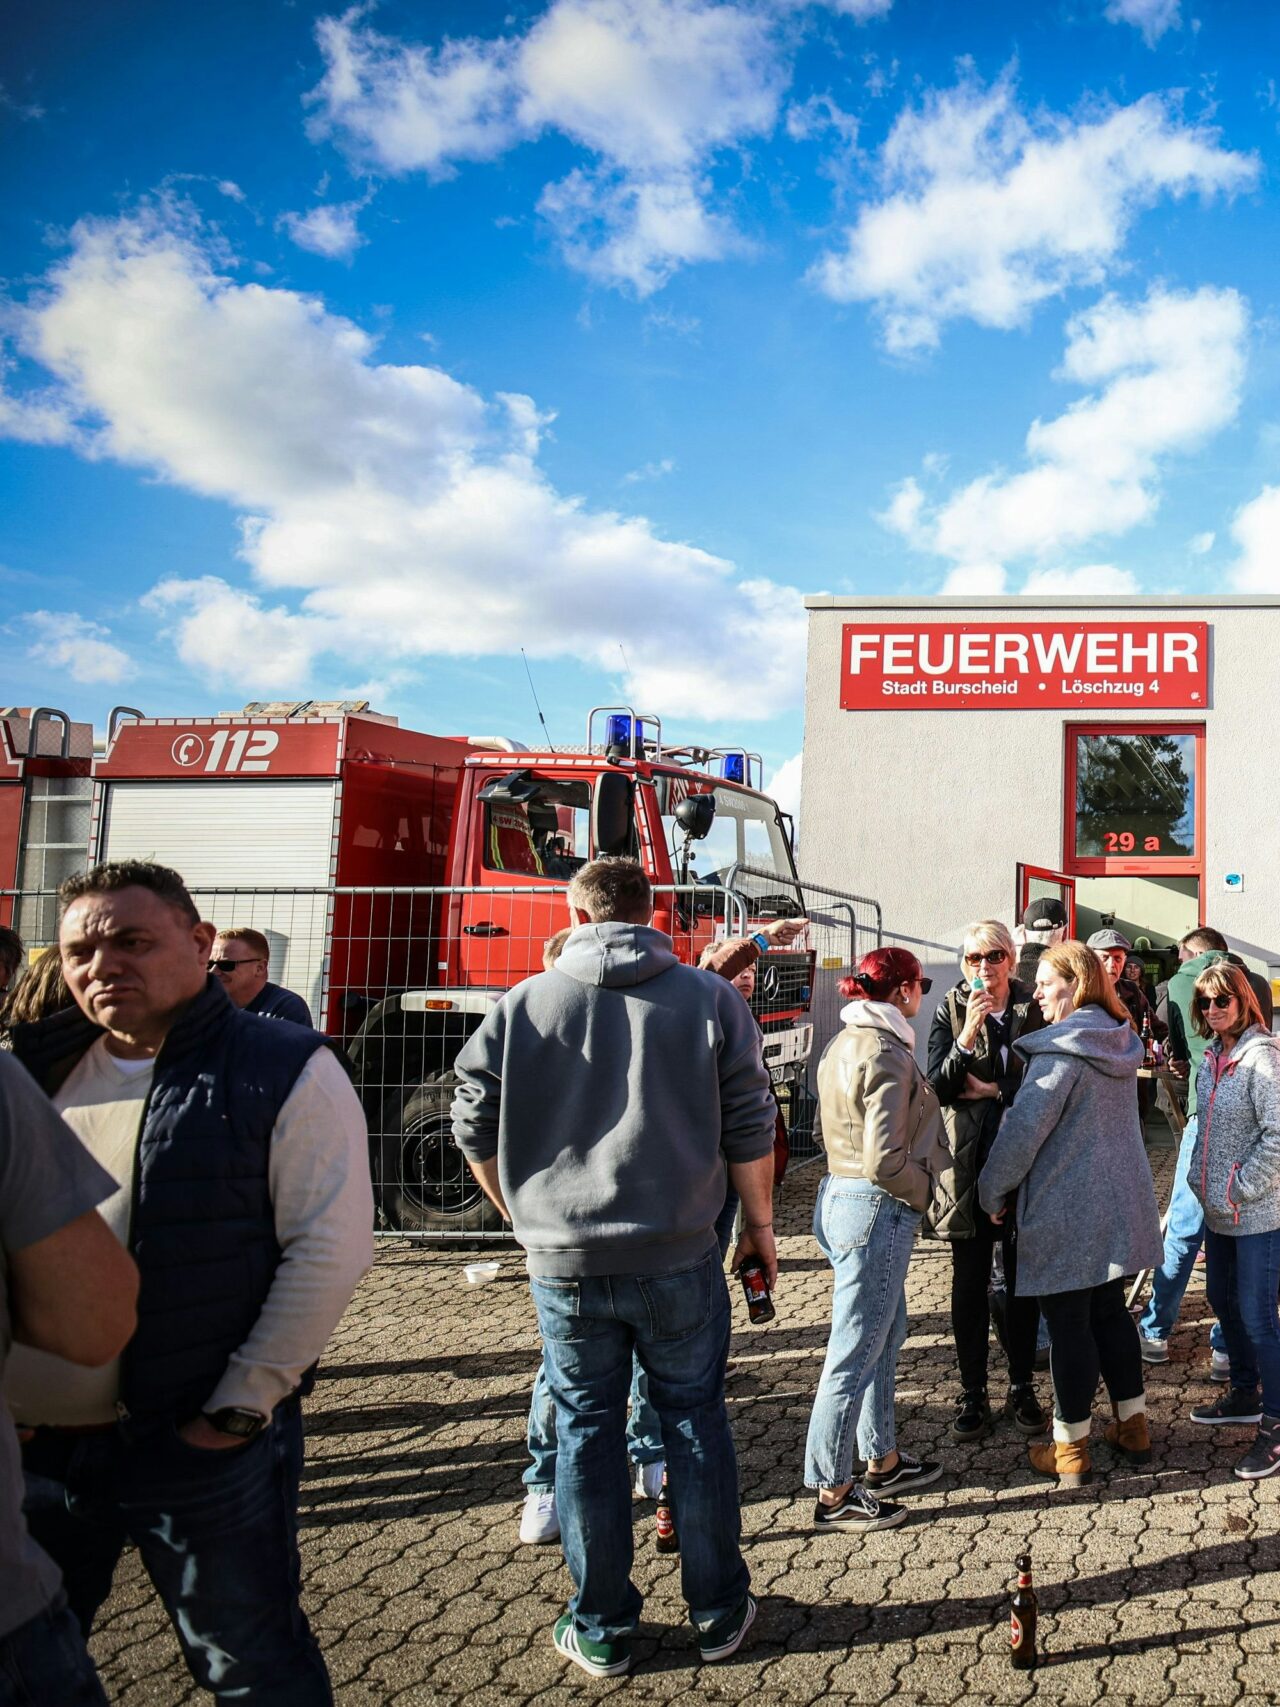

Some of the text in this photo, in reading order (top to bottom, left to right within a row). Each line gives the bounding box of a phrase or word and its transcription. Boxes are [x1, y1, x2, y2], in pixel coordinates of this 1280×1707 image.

[850, 633, 1199, 675] FEUERWEHR
[882, 679, 1160, 697] Stadt Burscheid Löschzug 4
[204, 730, 279, 772] 112
[1103, 832, 1161, 852] 29 a
